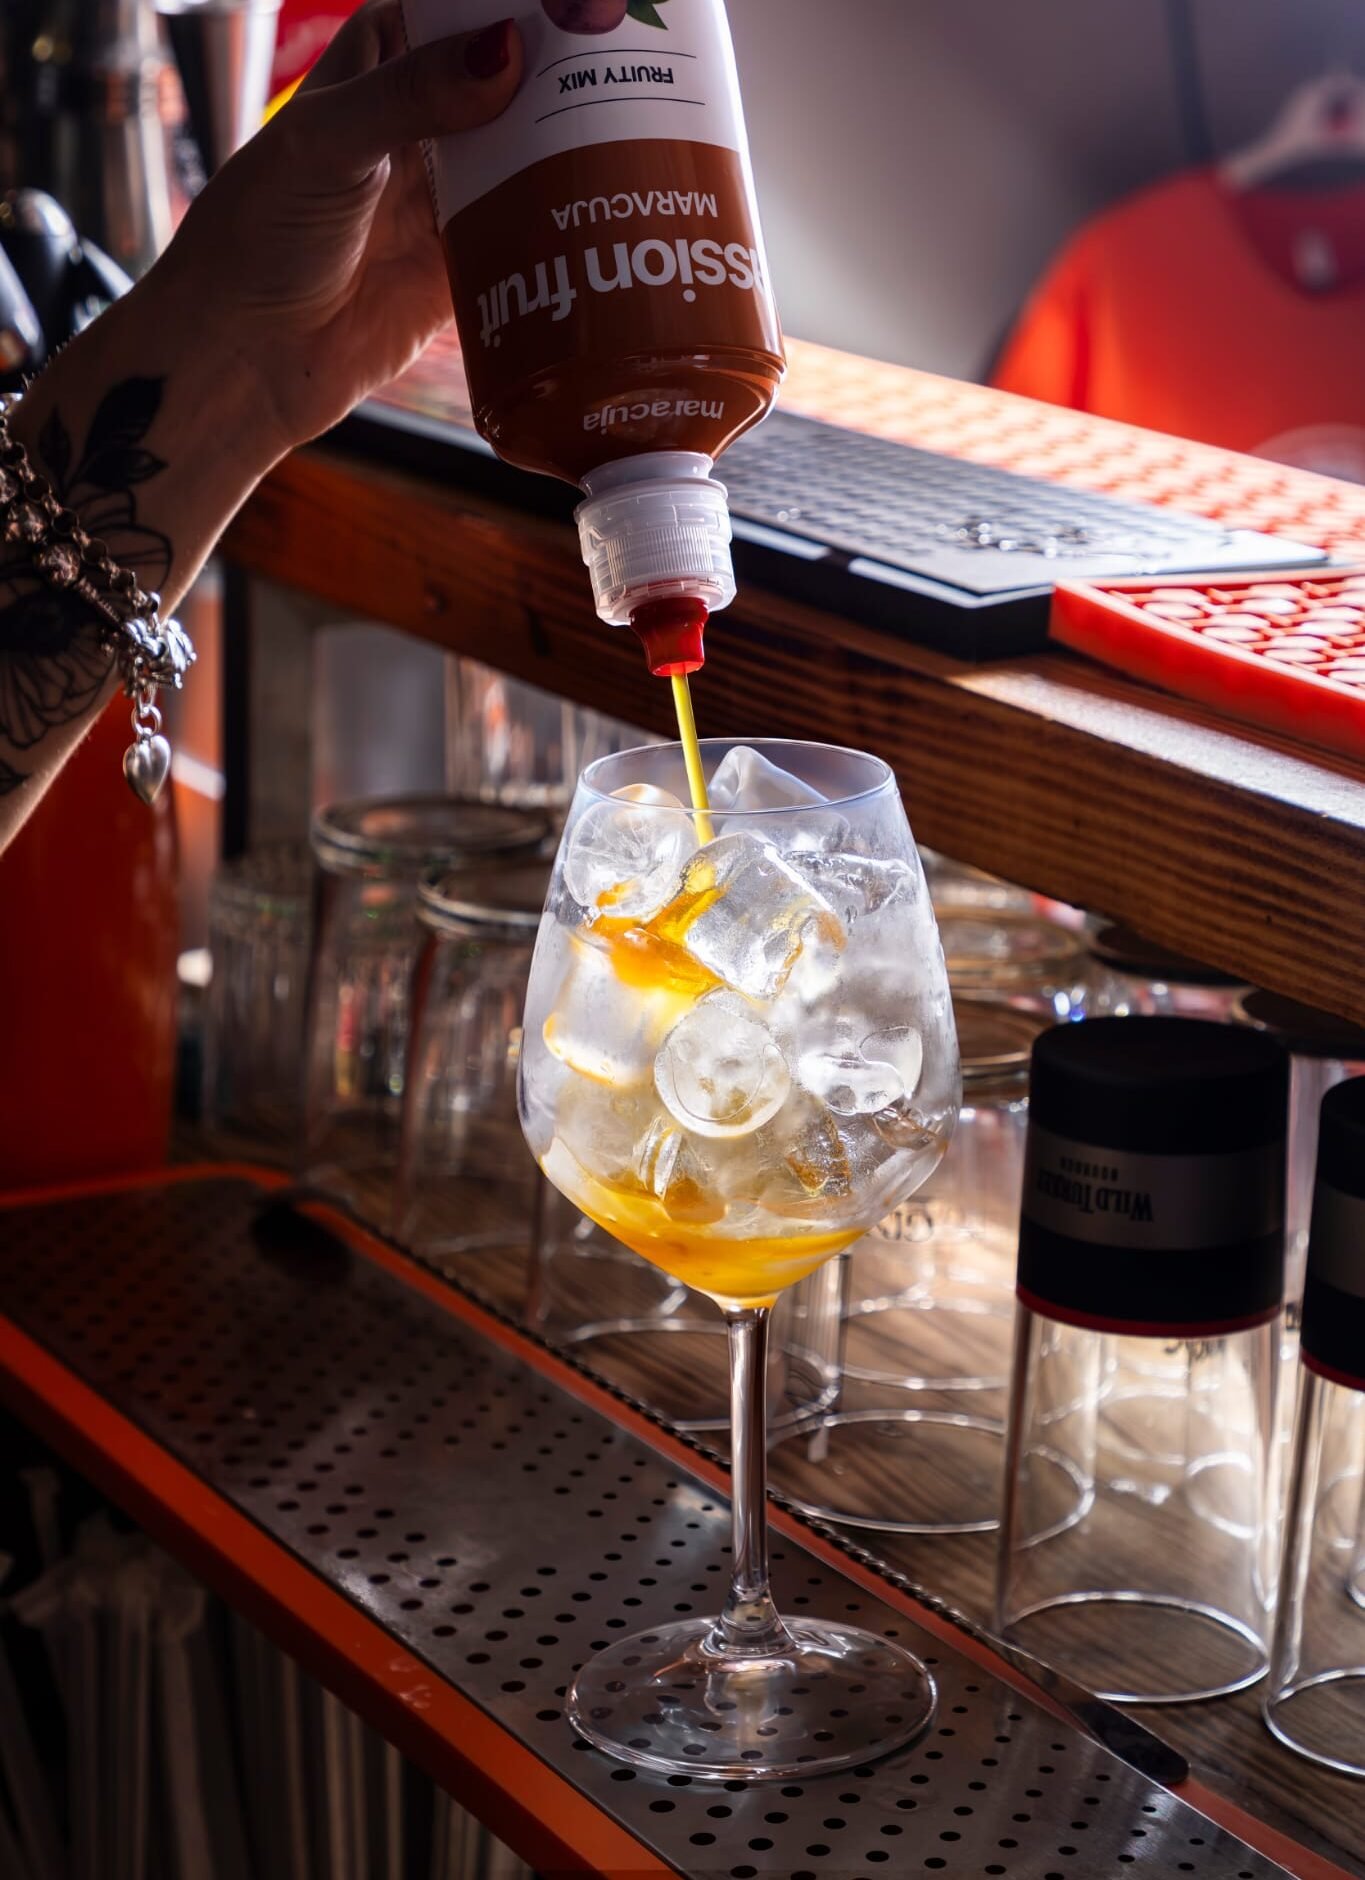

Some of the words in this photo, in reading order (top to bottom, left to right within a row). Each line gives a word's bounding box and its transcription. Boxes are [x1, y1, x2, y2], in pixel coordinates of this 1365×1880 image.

[558, 68, 598, 94] MIX
[604, 65, 674, 84] FRUITY
[551, 190, 719, 231] MARACUJA
[477, 254, 577, 348] fruit
[583, 399, 725, 435] maracuja
